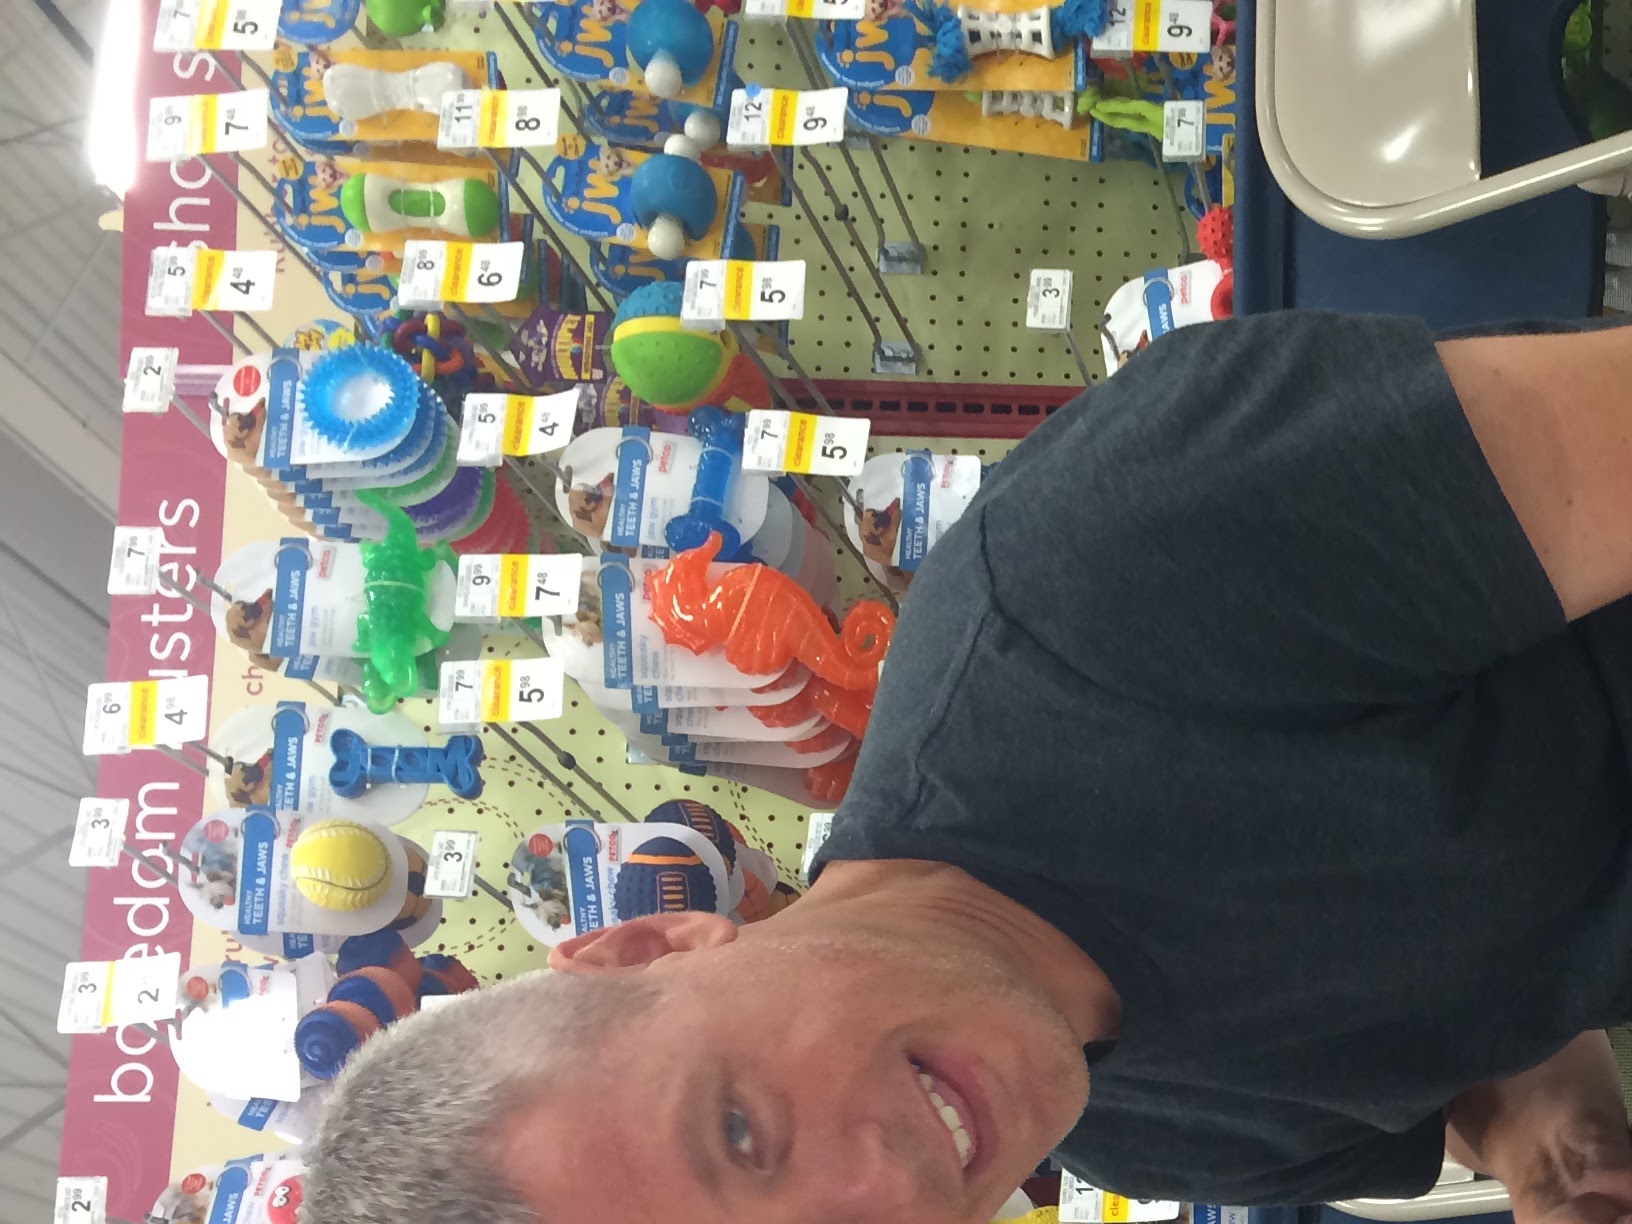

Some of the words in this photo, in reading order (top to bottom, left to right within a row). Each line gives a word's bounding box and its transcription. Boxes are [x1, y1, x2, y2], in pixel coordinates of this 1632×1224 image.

[448, 248, 463, 296] clearance
[731, 266, 745, 314] clearance
[281, 379, 293, 409] JAWS
[277, 422, 288, 458] TEETH
[510, 401, 526, 449] clearance
[791, 419, 808, 467] clearance
[629, 458, 643, 489] JAWS
[915, 482, 926, 514] JAWS
[625, 502, 638, 537] TEETH
[912, 527, 924, 560] TEETH
[289, 569, 301, 600] JAWS
[507, 560, 520, 611] clearance
[613, 591, 626, 626] JAWS
[284, 612, 297, 647] TEETH
[614, 640, 627, 679] TEETH
[489, 665, 503, 717] clearance
[287, 737, 298, 768] JAWS
[256, 841, 269, 875] JAWS
[582, 856, 595, 891] JAWS
[252, 888, 266, 925] TEETH
[223, 1192, 239, 1224] JAWS
